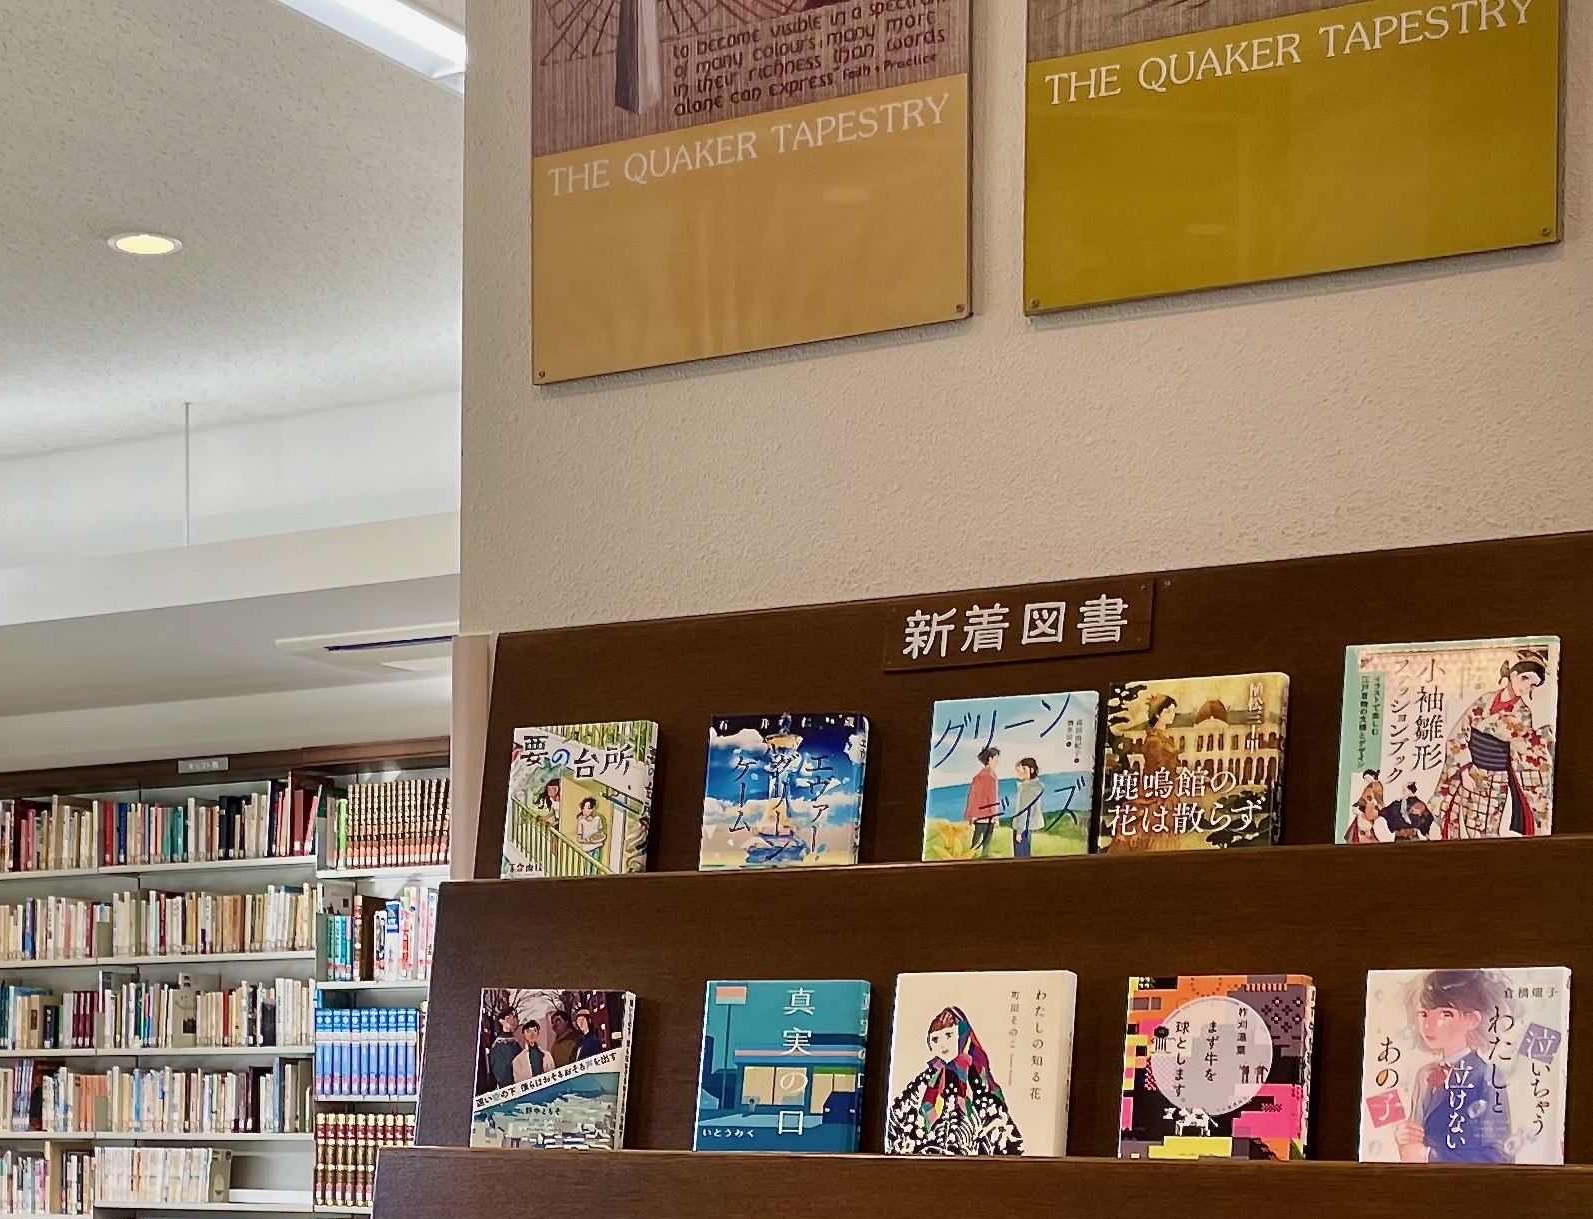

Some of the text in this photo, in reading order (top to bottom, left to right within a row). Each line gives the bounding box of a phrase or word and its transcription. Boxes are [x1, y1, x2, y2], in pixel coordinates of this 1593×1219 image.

[672, 43, 689, 60] to
[696, 29, 761, 55] become
[769, 11, 823, 41] visible
[830, 12, 848, 33] in
[851, 6, 862, 21] a
[673, 62, 688, 80] of
[695, 52, 744, 73] many
[826, 26, 876, 47] many
[886, 11, 936, 31] more
[673, 28, 945, 99] in their richness than words
[1044, 0, 1532, 105] THE QUAKER TAPESTRY
[673, 97, 723, 116] alone
[729, 86, 763, 104] can
[548, 93, 949, 196] THE QUAKER TAPESTRY
[902, 593, 1129, 660] 新着図書
[933, 693, 1072, 769] グリーン
[1385, 659, 1410, 785] ファッションブック
[1413, 658, 1445, 771] 小袖雛形
[520, 734, 634, 781] 要の台所
[728, 755, 762, 834] ゲーム
[1106, 768, 1237, 803] 鹿鳴館の
[975, 776, 1086, 858] デイズ
[1106, 796, 1266, 837] 花は散らず
[1009, 991, 1020, 1049] 町田そのこ
[1030, 989, 1047, 1100] わたしの知る花
[1204, 1020, 1219, 1082] まず牛を
[1487, 1006, 1515, 1113] わたしと
[778, 987, 816, 1136] 真実の口
[1173, 1021, 1190, 1103] 球とします。
[1370, 1036, 1401, 1121] あの子
[1524, 1029, 1556, 1136] 泣いちゃう
[703, 1128, 754, 1139] いとうみく
[1444, 1060, 1474, 1149] 泣けない
